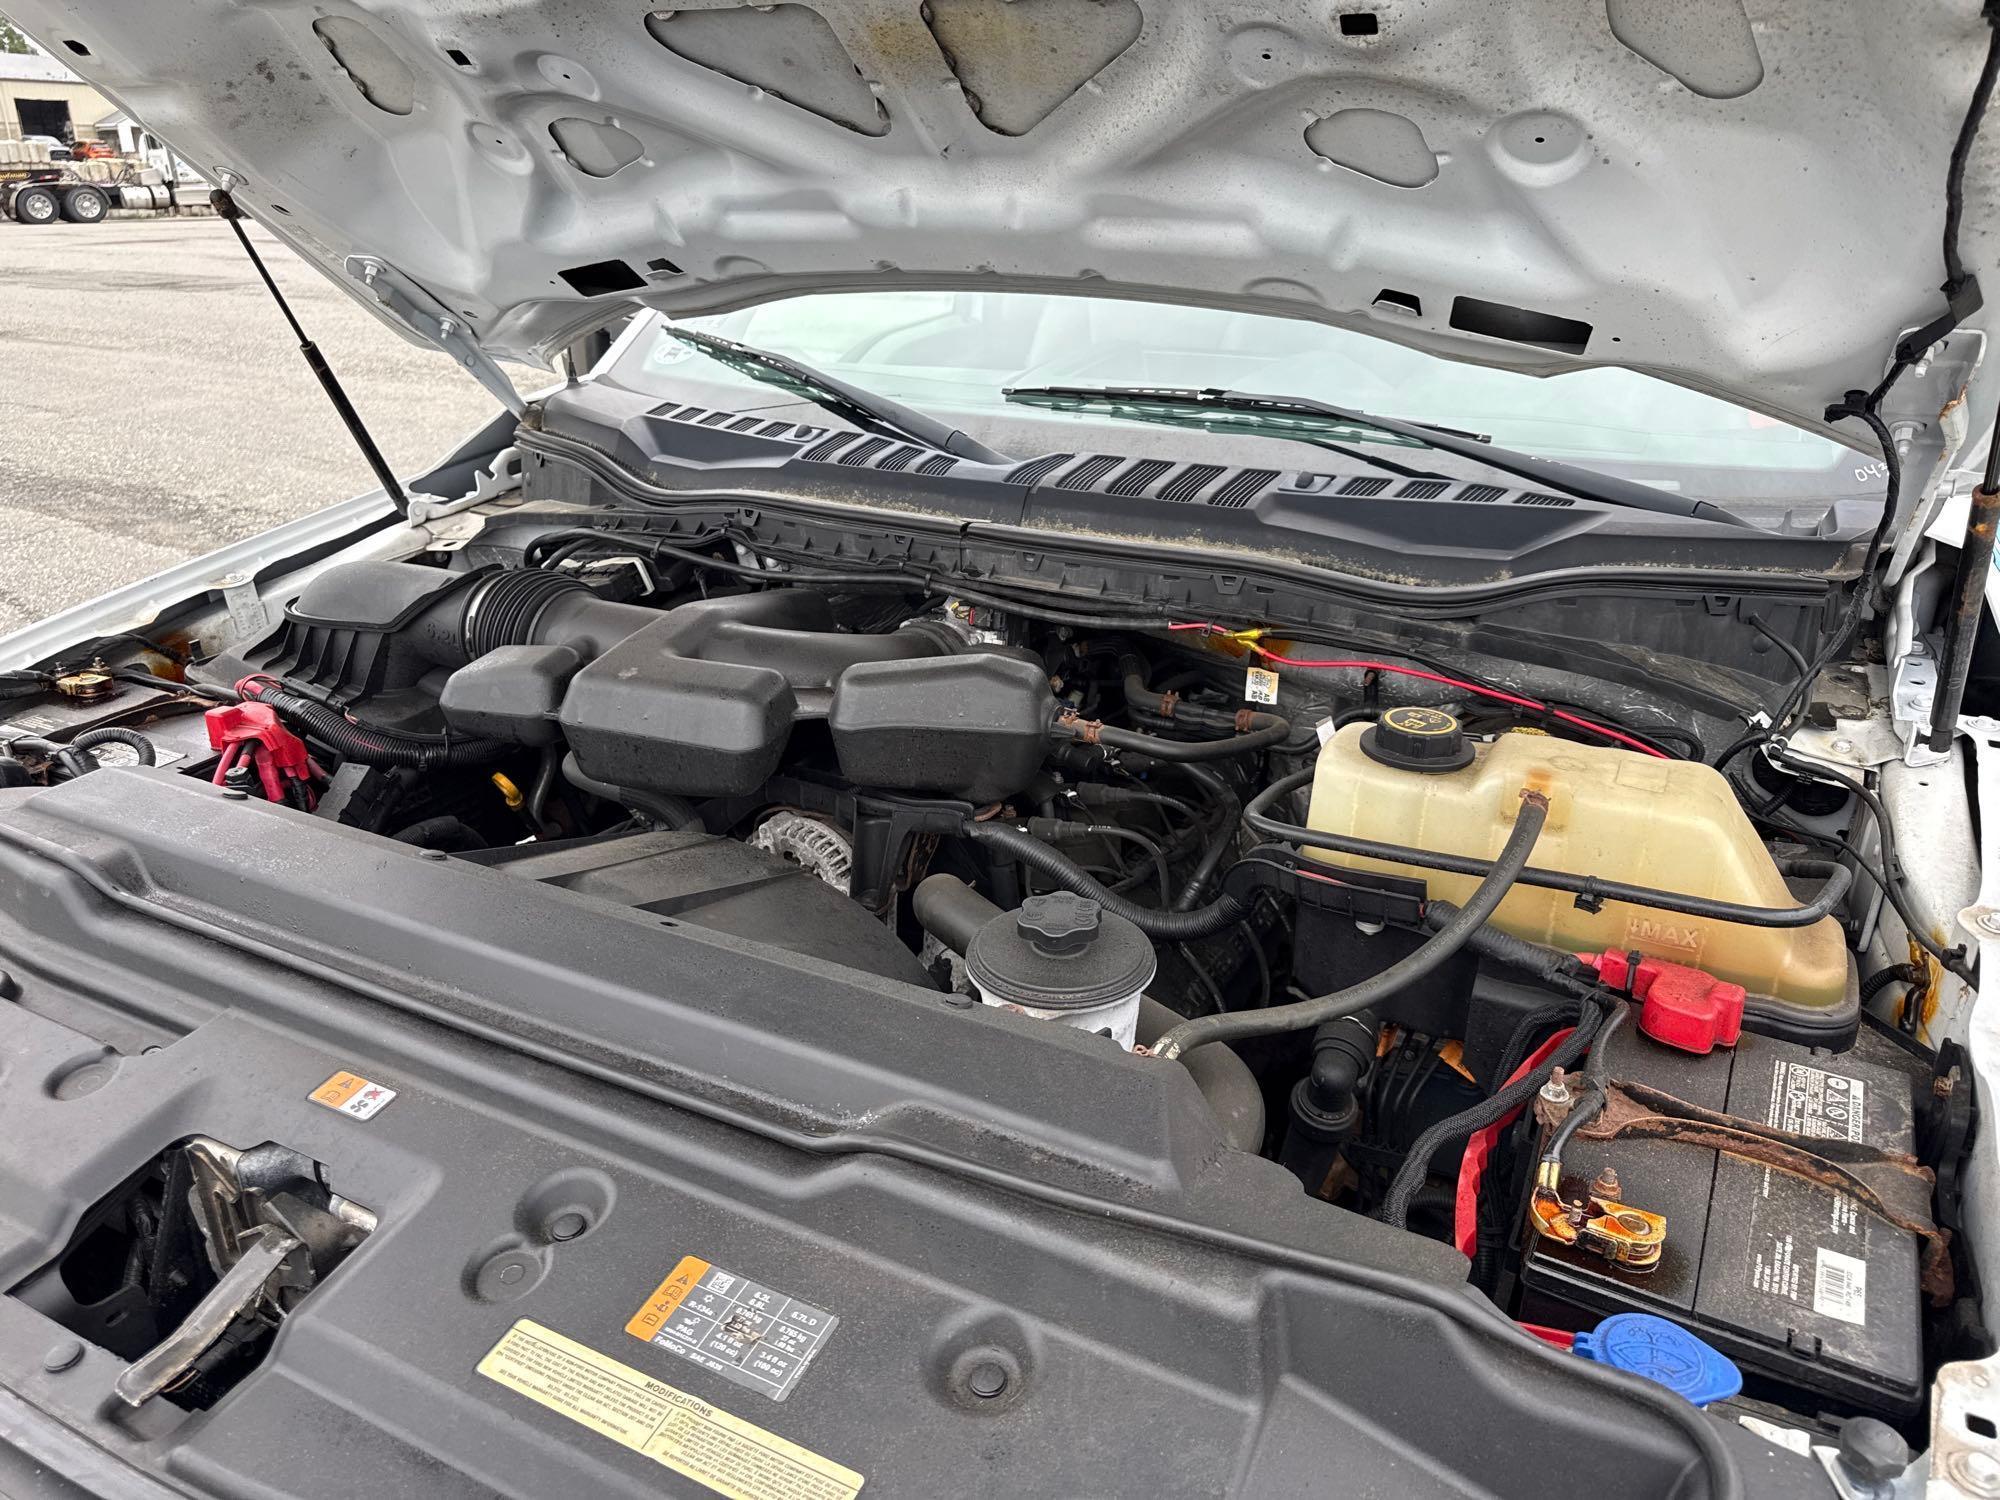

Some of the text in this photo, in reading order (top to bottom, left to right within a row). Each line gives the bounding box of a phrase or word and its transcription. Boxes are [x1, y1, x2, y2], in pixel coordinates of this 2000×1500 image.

[1640, 919, 1698, 949] MAX
[1853, 1101, 1862, 1144] DANGER/PO
[753, 1290, 773, 1303] 6.2L
[687, 1300, 715, 1316] R-134a
[790, 1310, 810, 1323] 6.7L
[675, 1323, 695, 1336] PAG
[714, 1331, 728, 1341] 4.1
[653, 1335, 688, 1354] FoMoCo
[645, 1381, 714, 1418] MODIFICATIONS
